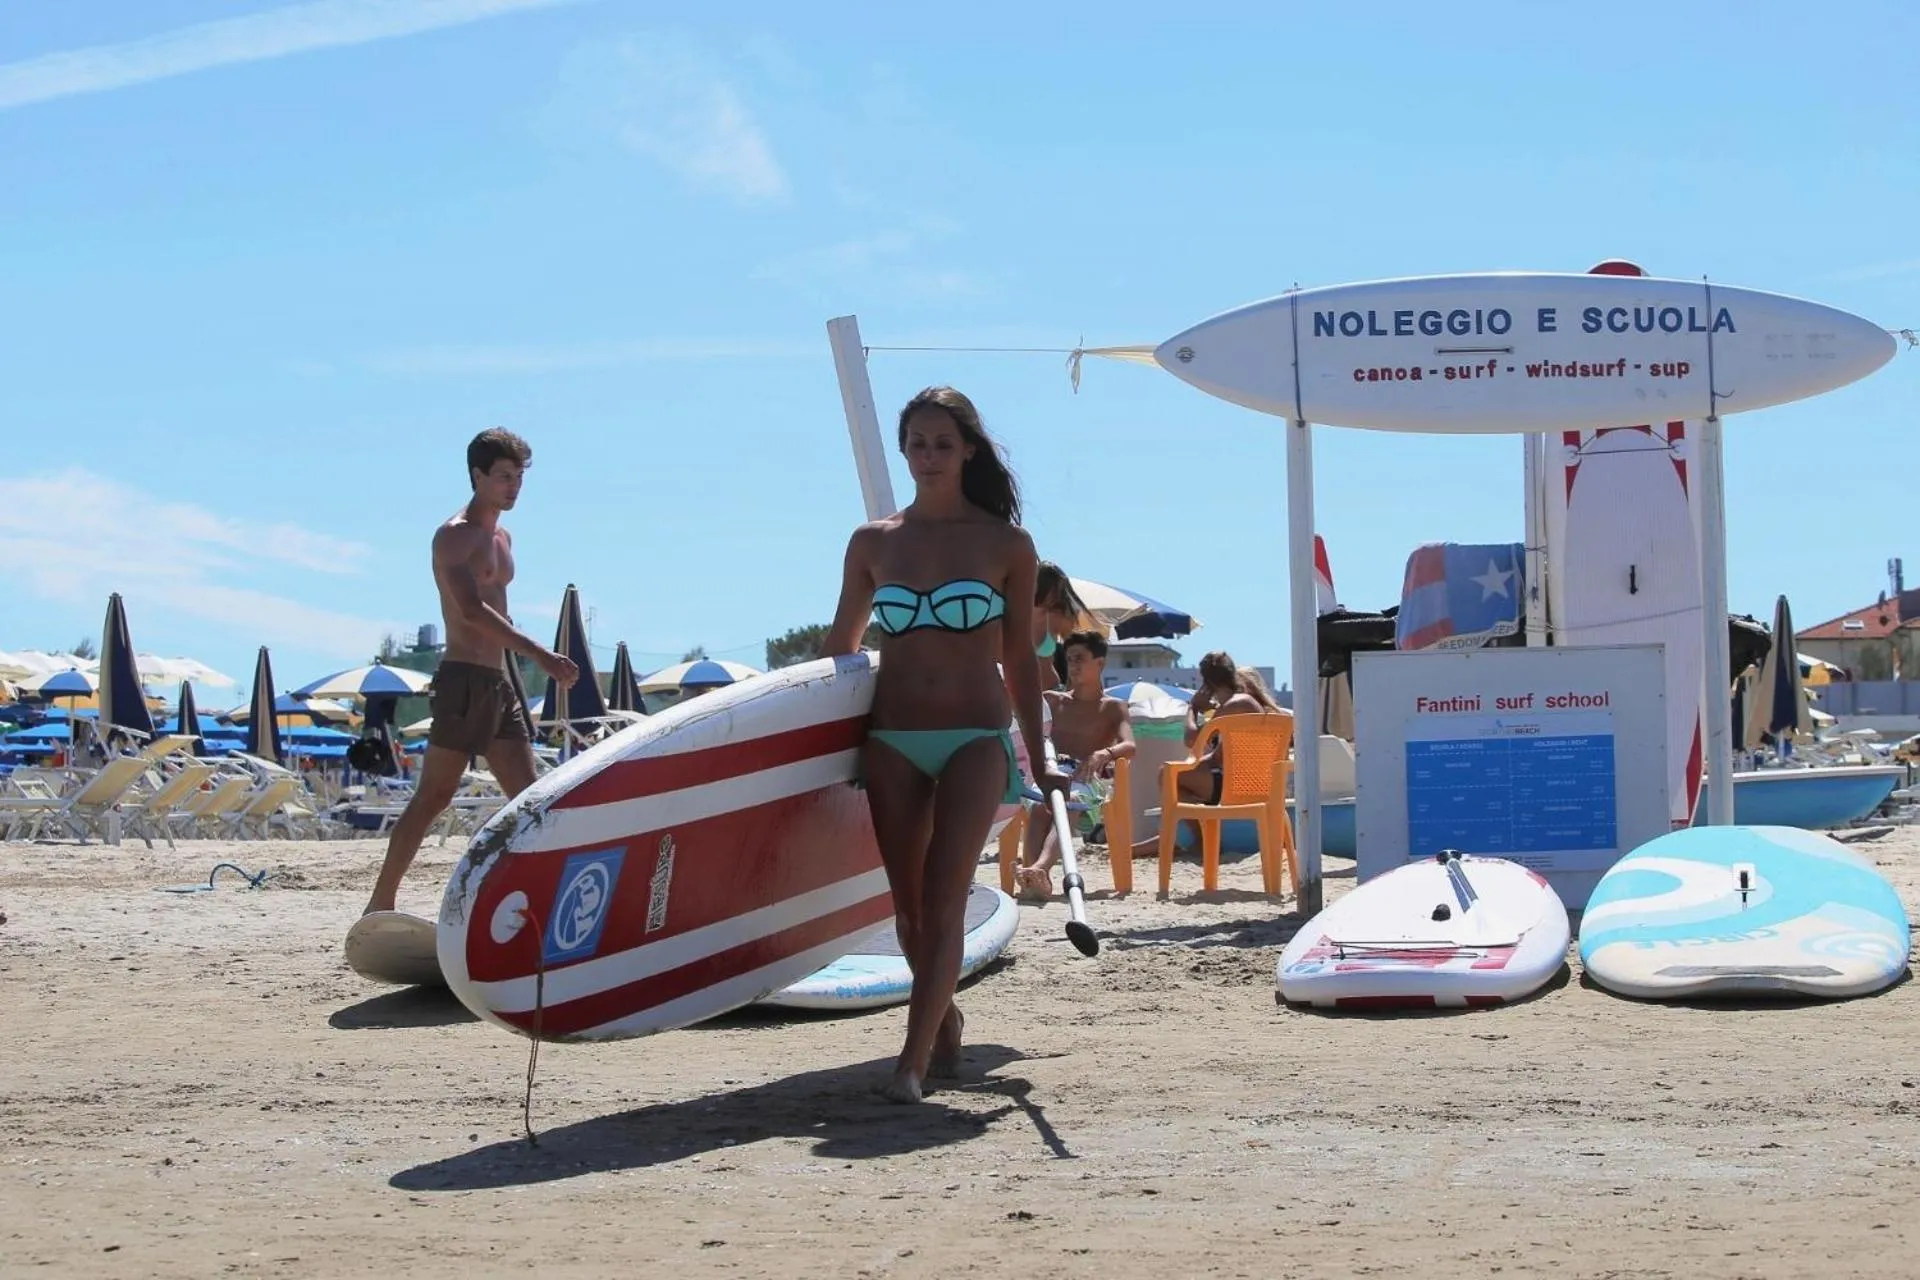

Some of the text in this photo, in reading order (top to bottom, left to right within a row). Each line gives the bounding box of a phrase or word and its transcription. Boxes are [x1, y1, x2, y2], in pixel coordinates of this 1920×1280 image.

[1313, 305, 1737, 337] NOLEGGIO E SCUOLA
[1352, 366, 1423, 382] canoa
[1443, 359, 1498, 380] surf
[1524, 358, 1627, 379] windsurf
[1648, 360, 1691, 379] sup
[1416, 691, 1610, 713] Fantini surf school
